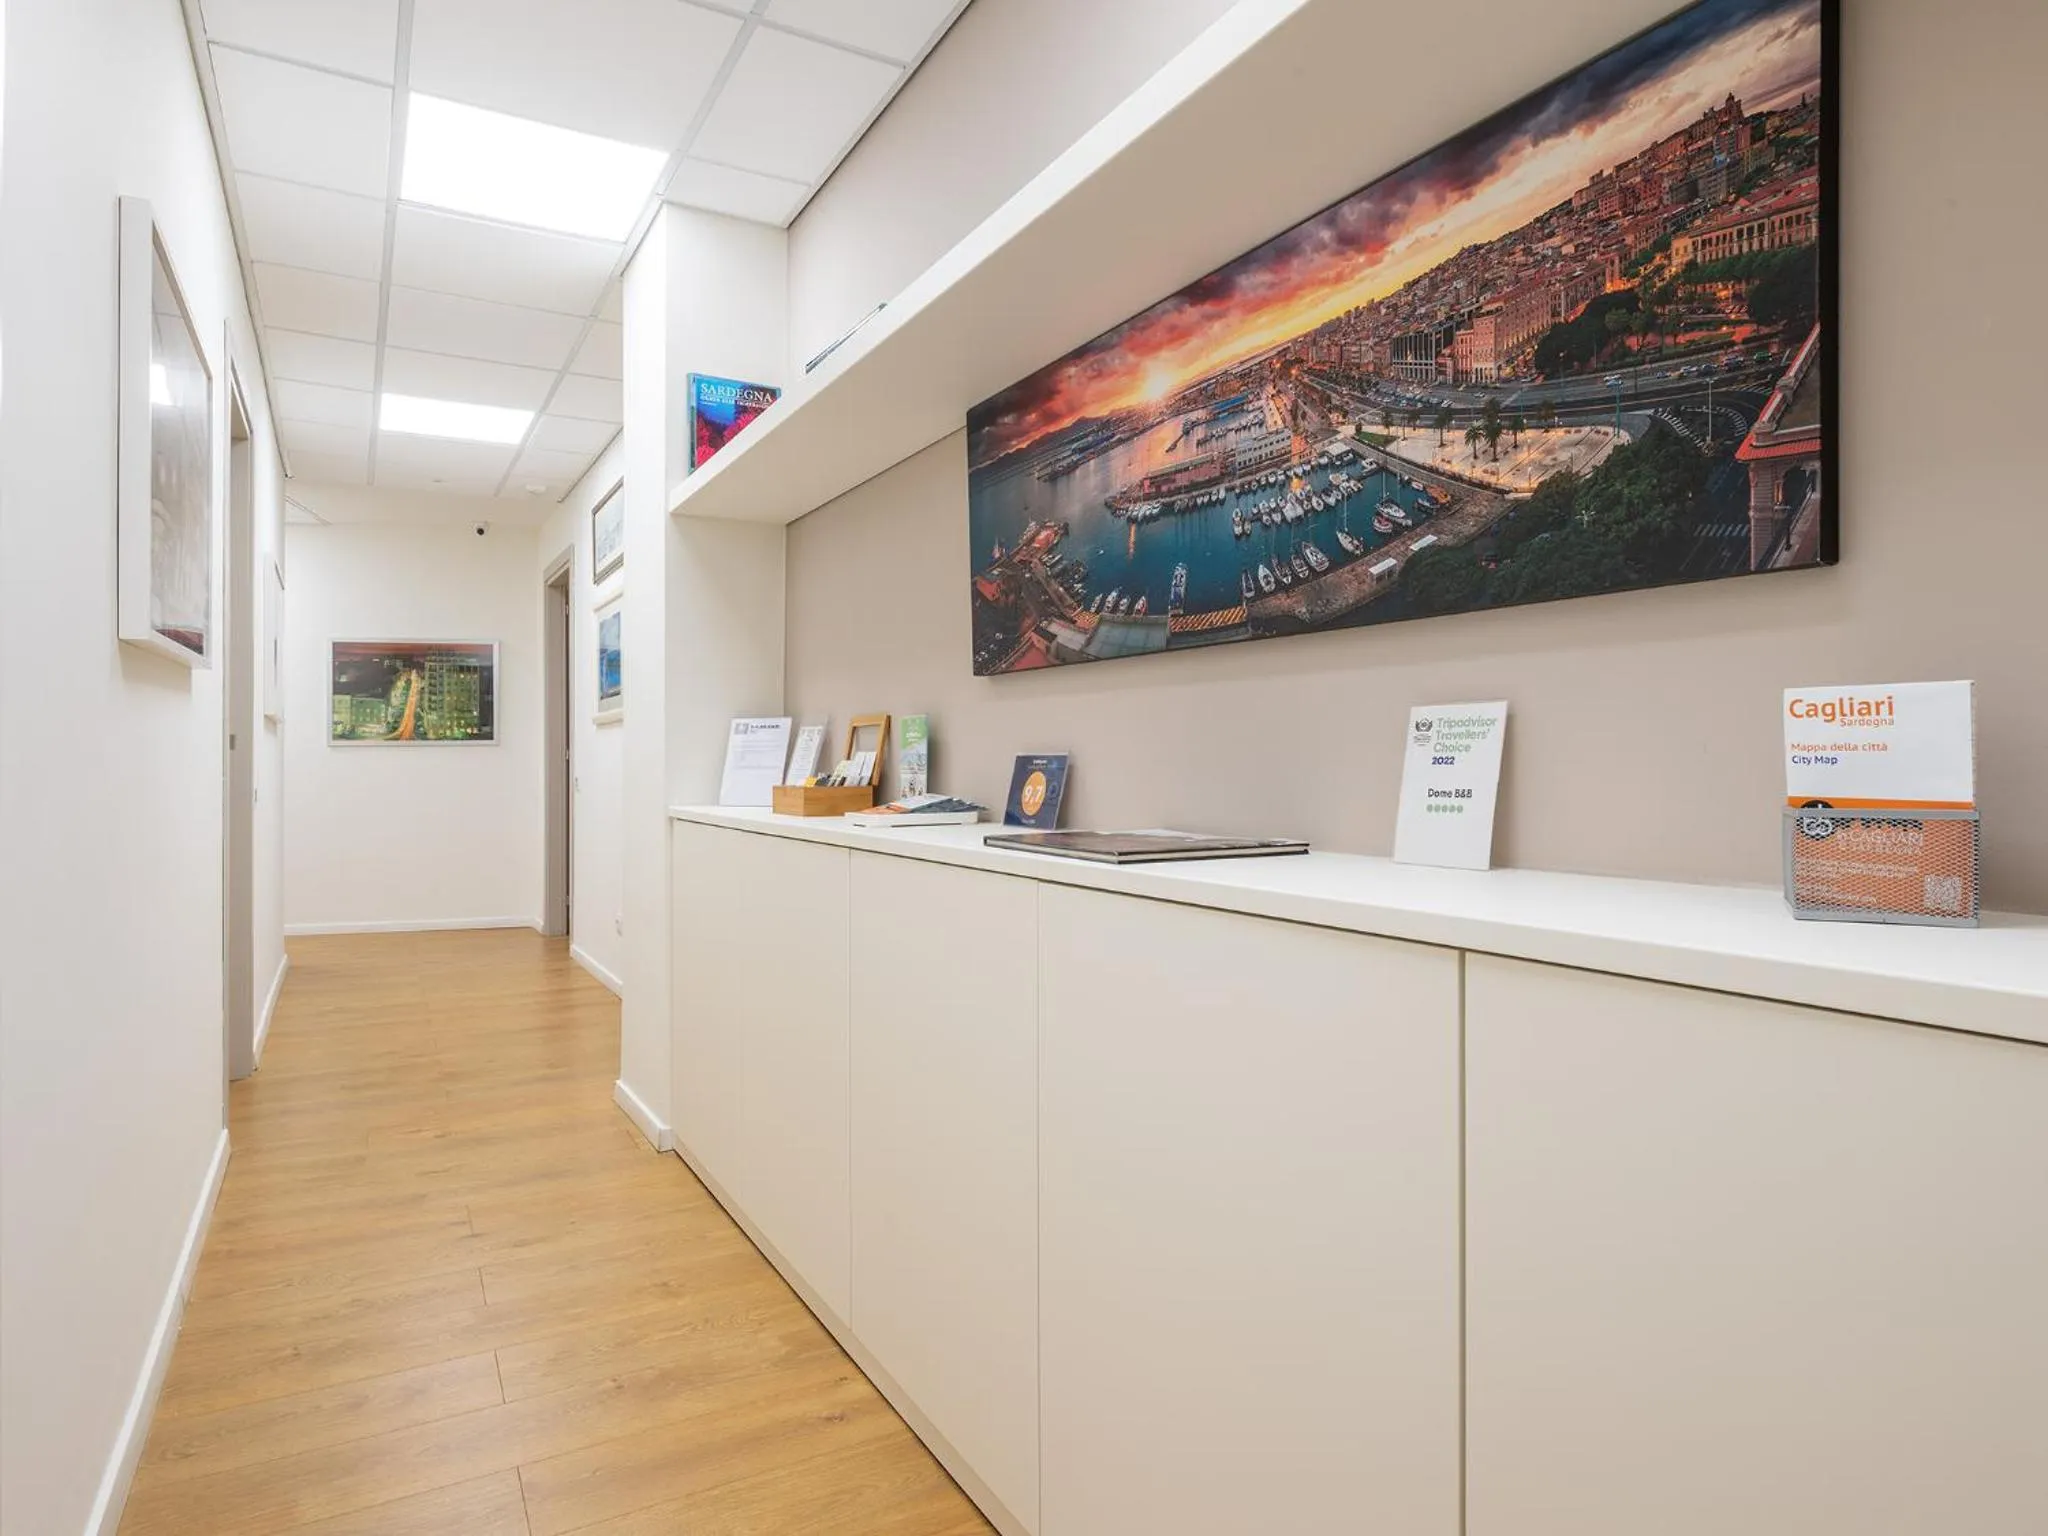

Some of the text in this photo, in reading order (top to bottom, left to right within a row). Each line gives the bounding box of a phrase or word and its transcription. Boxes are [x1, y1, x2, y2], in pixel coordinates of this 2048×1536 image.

[701, 383, 773, 403] SARDEGNA
[1790, 695, 1894, 723] Cagliari
[1437, 716, 1497, 729] Tripadvisor
[1840, 717, 1895, 728] Sardegna
[1433, 742, 1471, 753] Choice
[1791, 741, 1888, 753] Mappa della città
[1431, 756, 1455, 766] 2022
[1792, 755, 1839, 766] City Map
